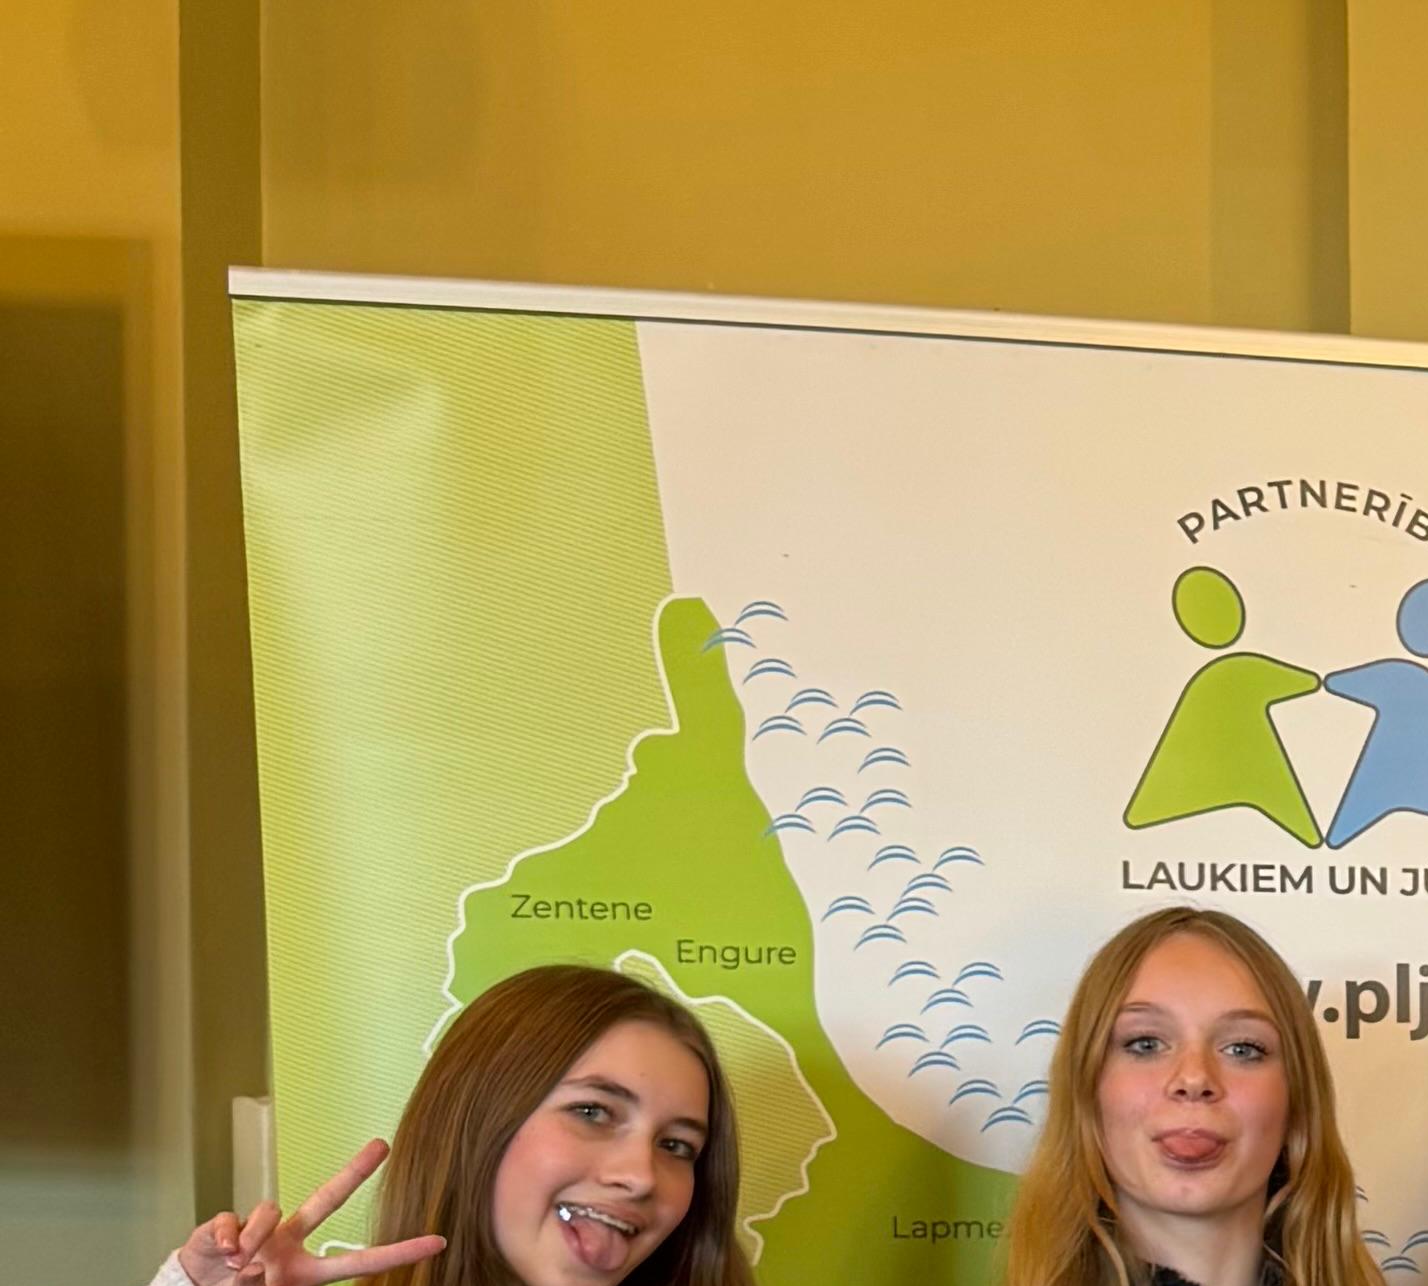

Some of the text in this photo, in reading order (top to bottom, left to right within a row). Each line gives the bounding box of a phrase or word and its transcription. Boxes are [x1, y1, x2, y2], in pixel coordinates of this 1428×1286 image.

[1121, 860, 1314, 895] LAUKIEM
[1328, 866, 1388, 896] UN
[510, 894, 653, 922] Zentene
[676, 939, 797, 969] Engure
[893, 1216, 1010, 1244] Lapme
